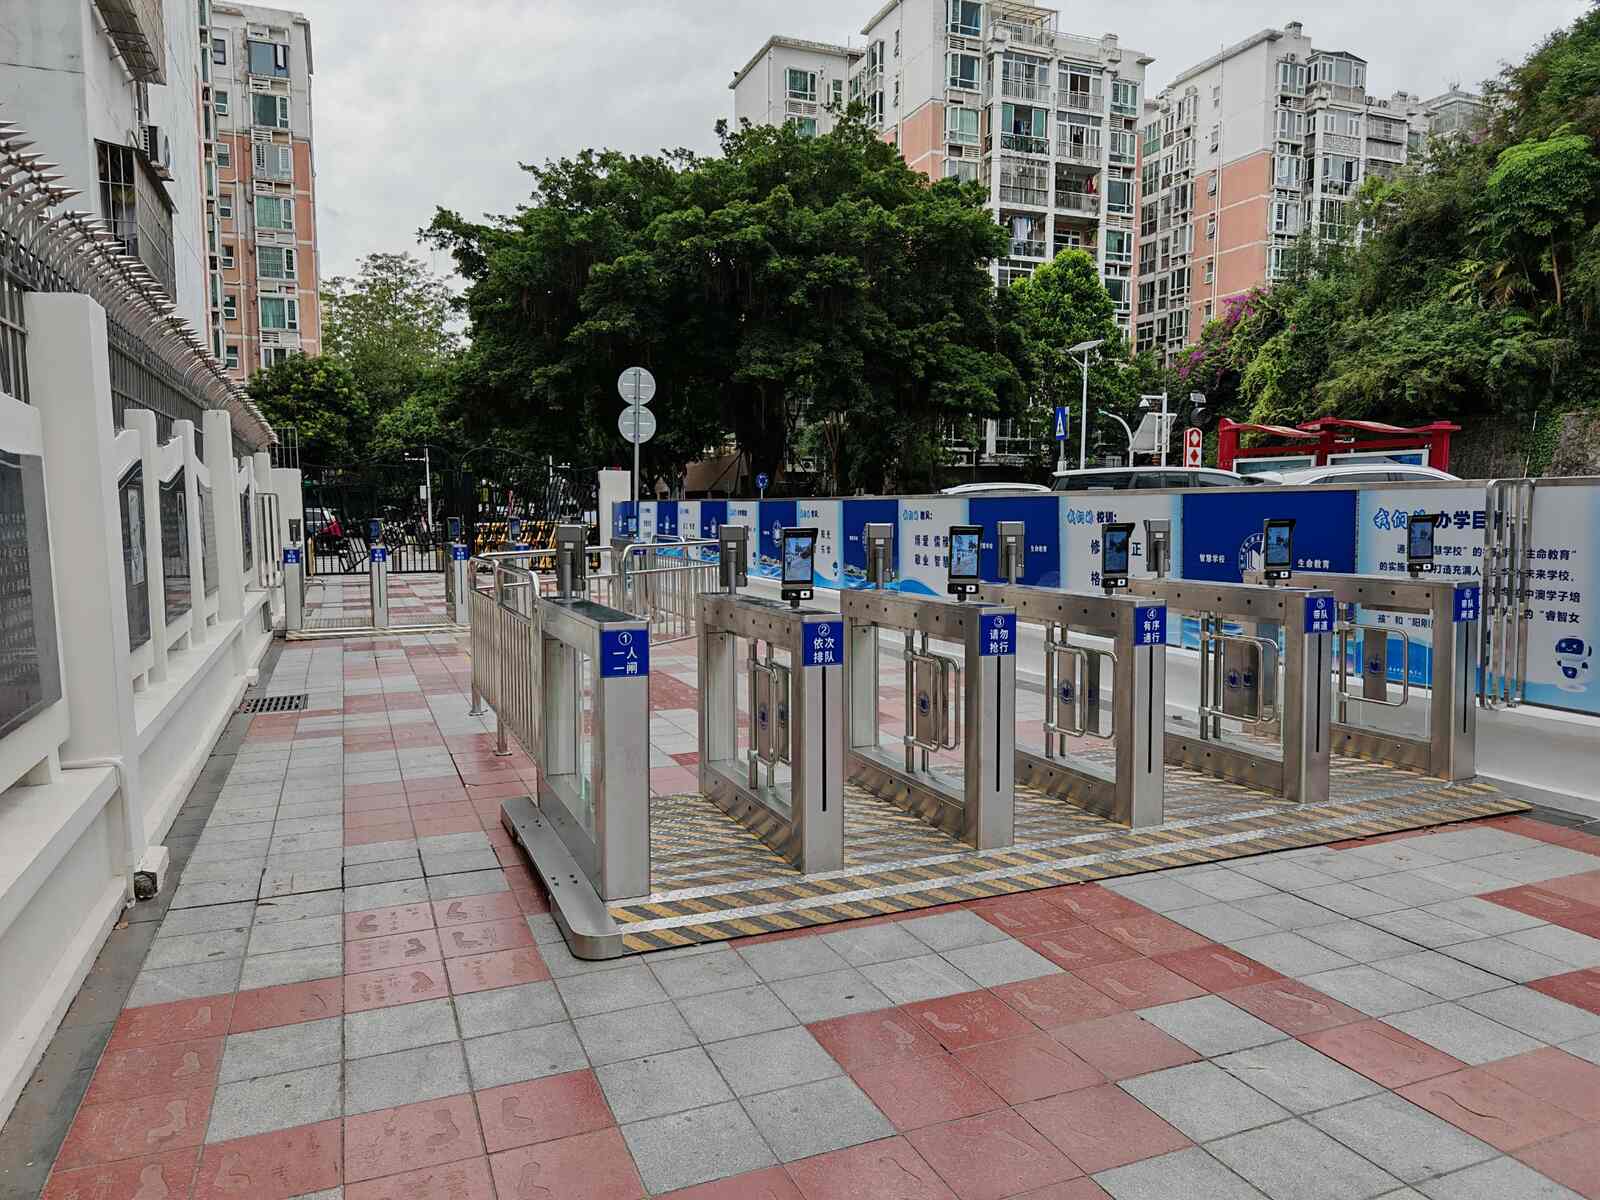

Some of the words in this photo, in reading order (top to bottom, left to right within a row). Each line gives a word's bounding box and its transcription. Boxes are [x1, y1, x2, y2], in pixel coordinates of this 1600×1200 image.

[1373, 508, 1425, 530] 我们
[1131, 542, 1143, 556] 正
[1297, 558, 1331, 570] 生命教育
[1313, 609, 1328, 620] 带队
[1143, 620, 1160, 632] 有序
[990, 628, 1009, 641] 请勿
[1143, 632, 1160, 644] 通行
[813, 637, 835, 650] 依次
[989, 641, 1008, 653] 抢行
[612, 646, 638, 660] 一人
[813, 651, 835, 664] 排队
[612, 661, 638, 675] 一闸
